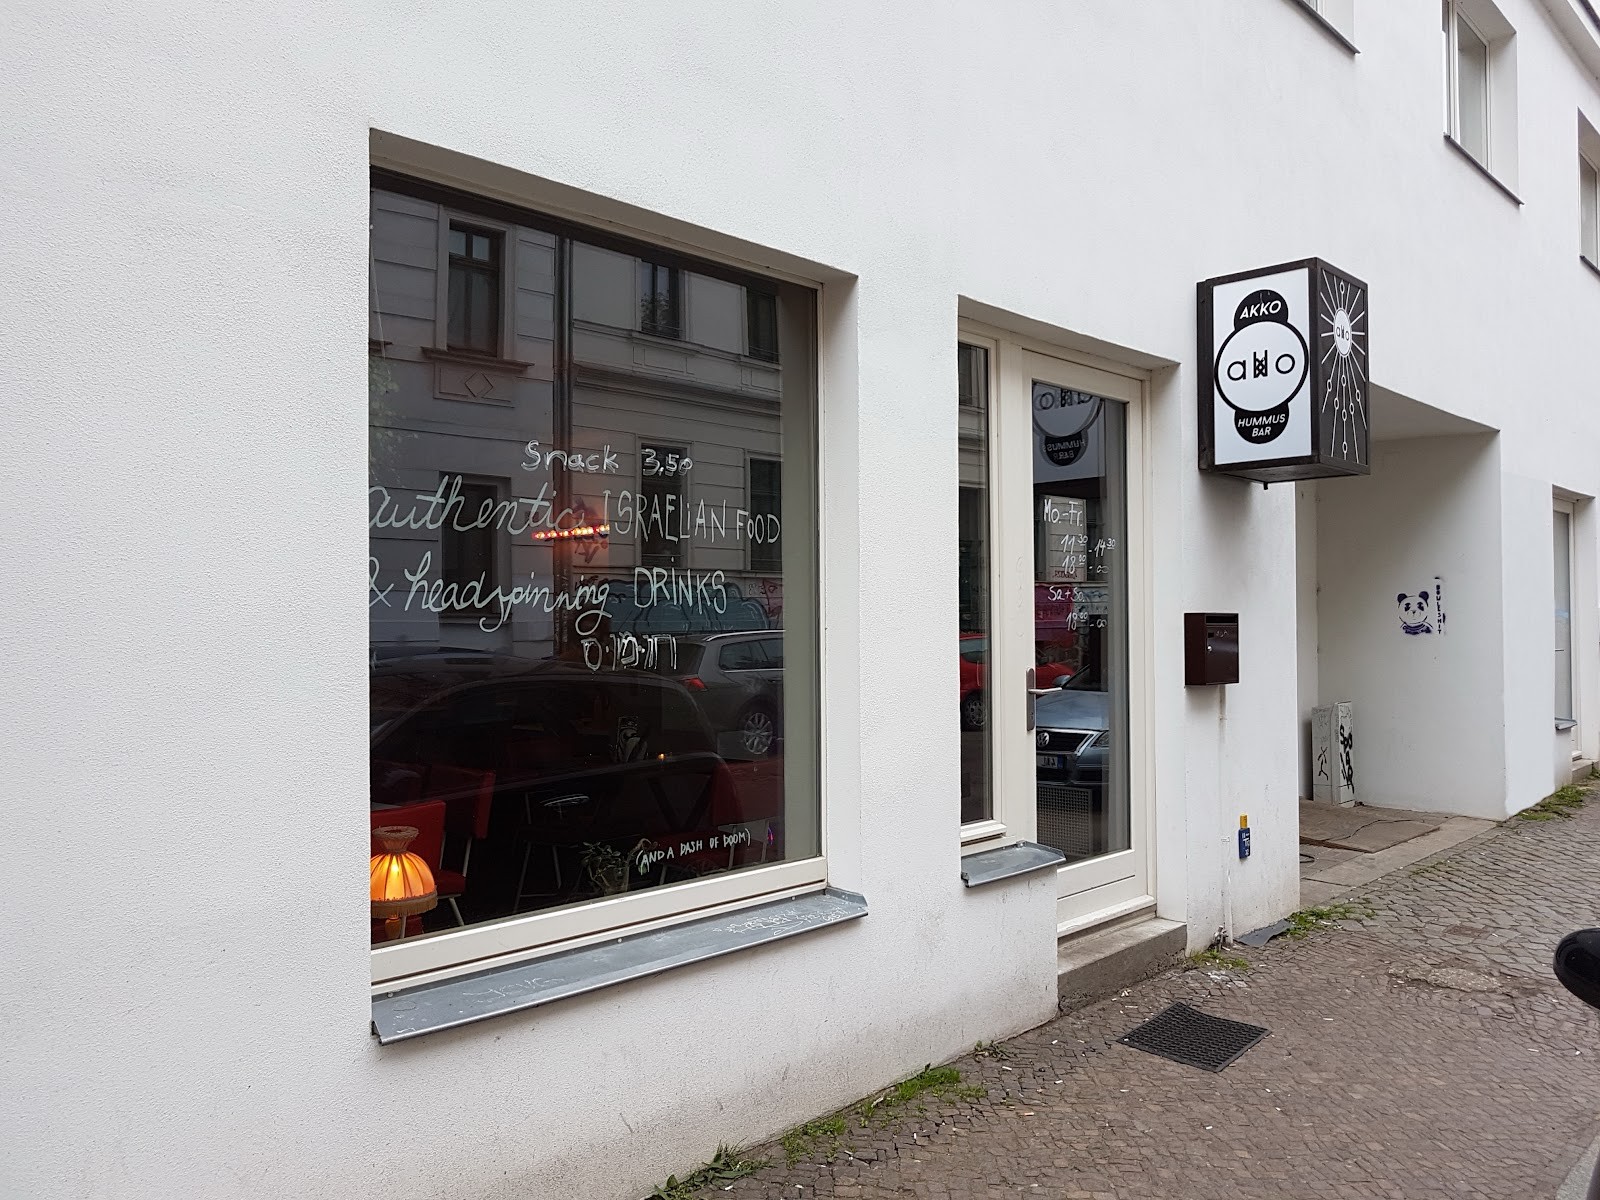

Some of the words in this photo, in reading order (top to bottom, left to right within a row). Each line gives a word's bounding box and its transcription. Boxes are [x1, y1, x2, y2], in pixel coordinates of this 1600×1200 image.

[1239, 299, 1282, 320] AKKO
[1237, 413, 1286, 428] HUMMUS
[1251, 426, 1271, 437] BAR
[521, 440, 619, 473] Snack
[641, 448, 694, 477] 3,50
[368, 475, 586, 535] authentic
[680, 839, 703, 857] DASH
[709, 836, 719, 849] OF
